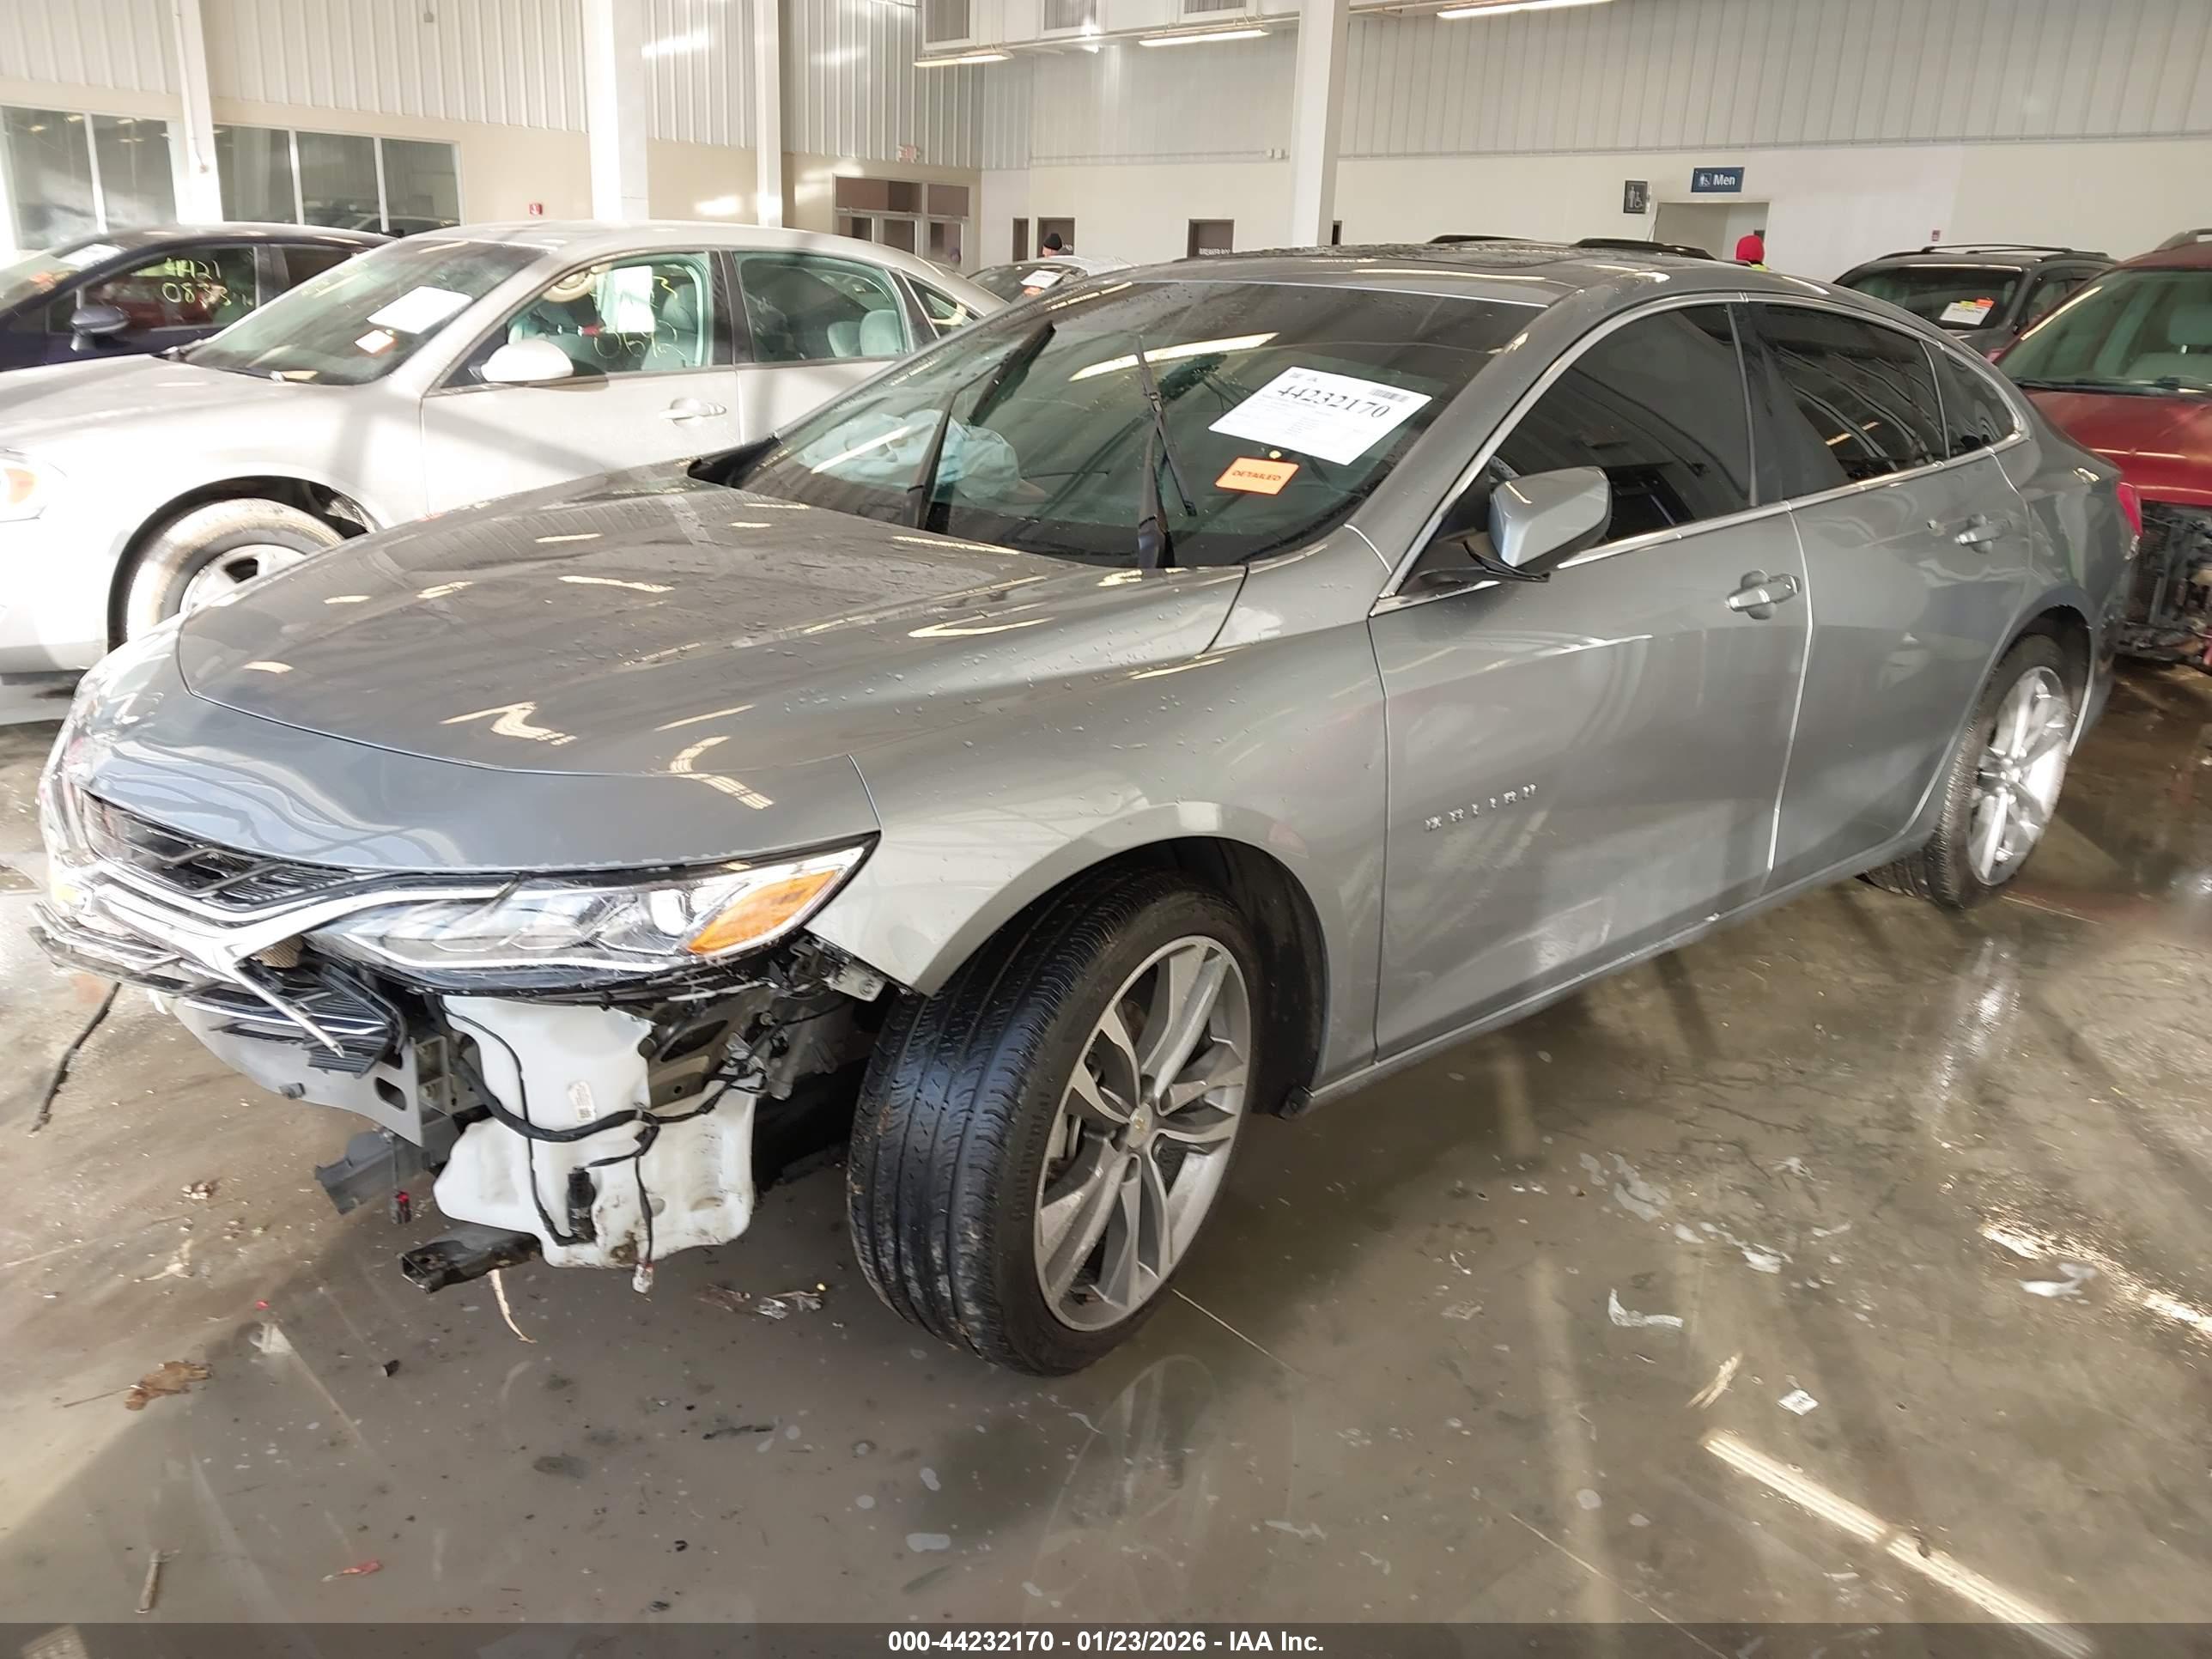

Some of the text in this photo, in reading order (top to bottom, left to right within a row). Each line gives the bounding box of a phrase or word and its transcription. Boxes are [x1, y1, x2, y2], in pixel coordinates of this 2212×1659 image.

[1713, 174, 1735, 185] Men
[1277, 385, 1391, 418] 44232170
[1231, 469, 1281, 482] DETAILED
